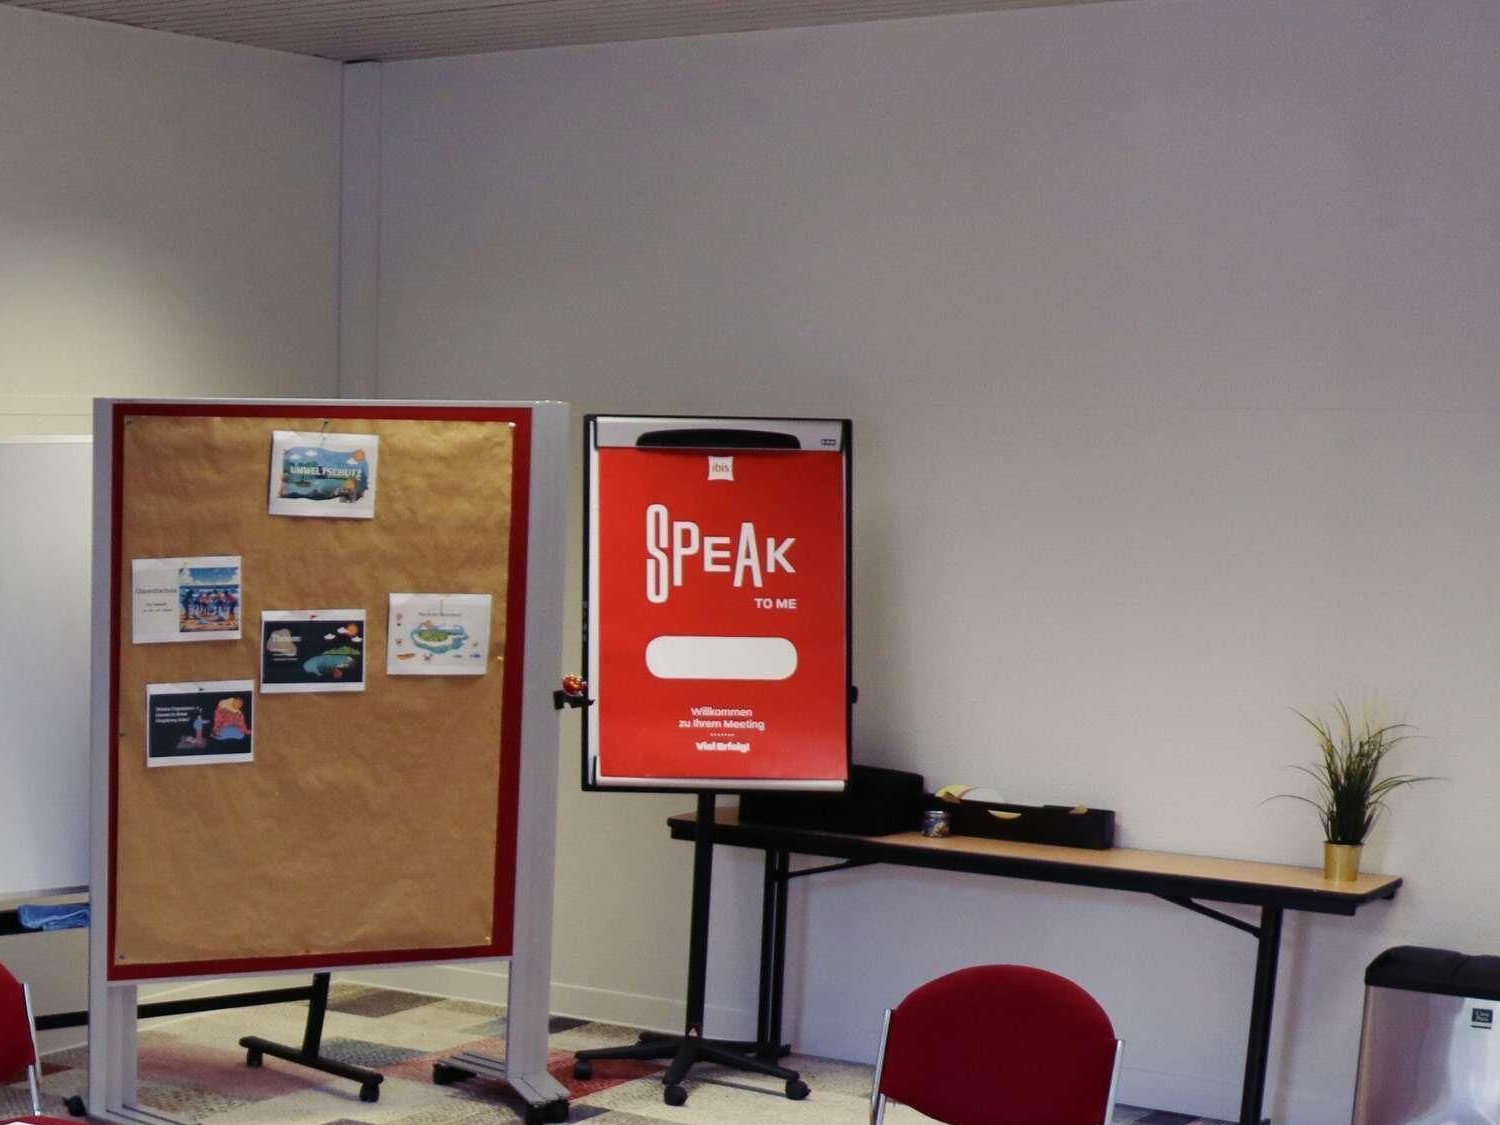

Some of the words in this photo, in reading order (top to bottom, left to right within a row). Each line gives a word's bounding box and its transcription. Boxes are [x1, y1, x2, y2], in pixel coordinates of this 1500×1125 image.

[646, 503, 796, 604] SPEAK
[754, 598, 773, 609] TO
[776, 598, 797, 609] ME
[690, 706, 753, 717] Willkommen
[678, 719, 691, 728] zu
[693, 718, 722, 729] Ihrem
[723, 719, 765, 731] Meeting
